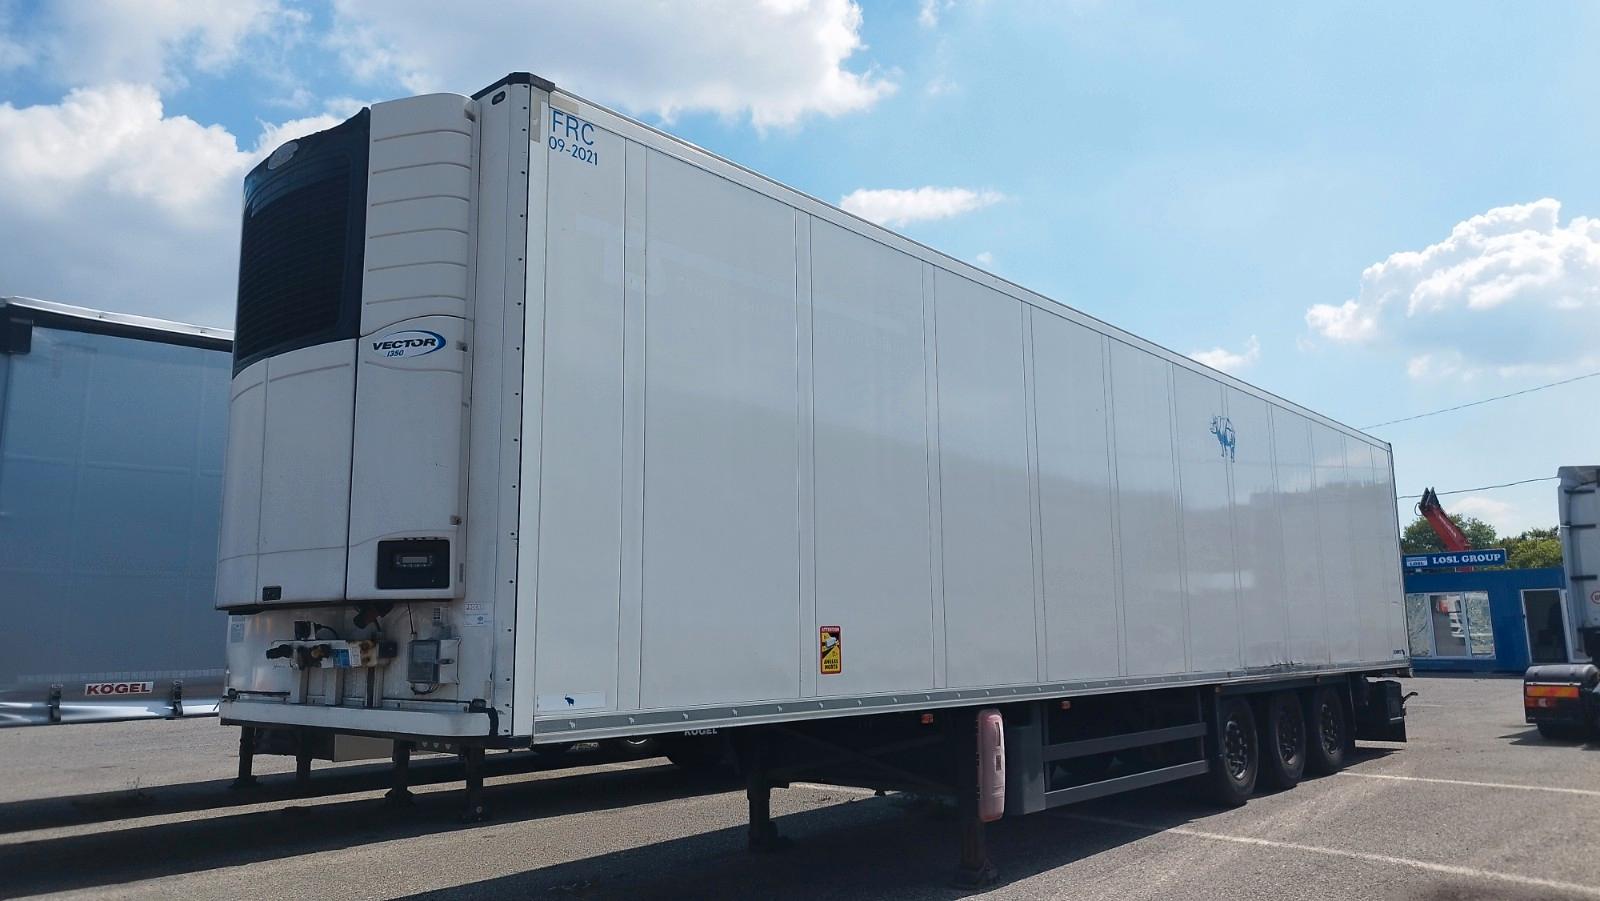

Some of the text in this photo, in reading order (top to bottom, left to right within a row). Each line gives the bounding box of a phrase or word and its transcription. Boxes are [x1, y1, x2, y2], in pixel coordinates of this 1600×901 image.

[553, 110, 594, 146] FRC
[548, 135, 598, 166] 09-2021
[372, 338, 437, 351] VECTOR
[386, 349, 405, 358] 1350
[1432, 556, 1460, 565] LOSL
[1462, 553, 1501, 563] GROUP
